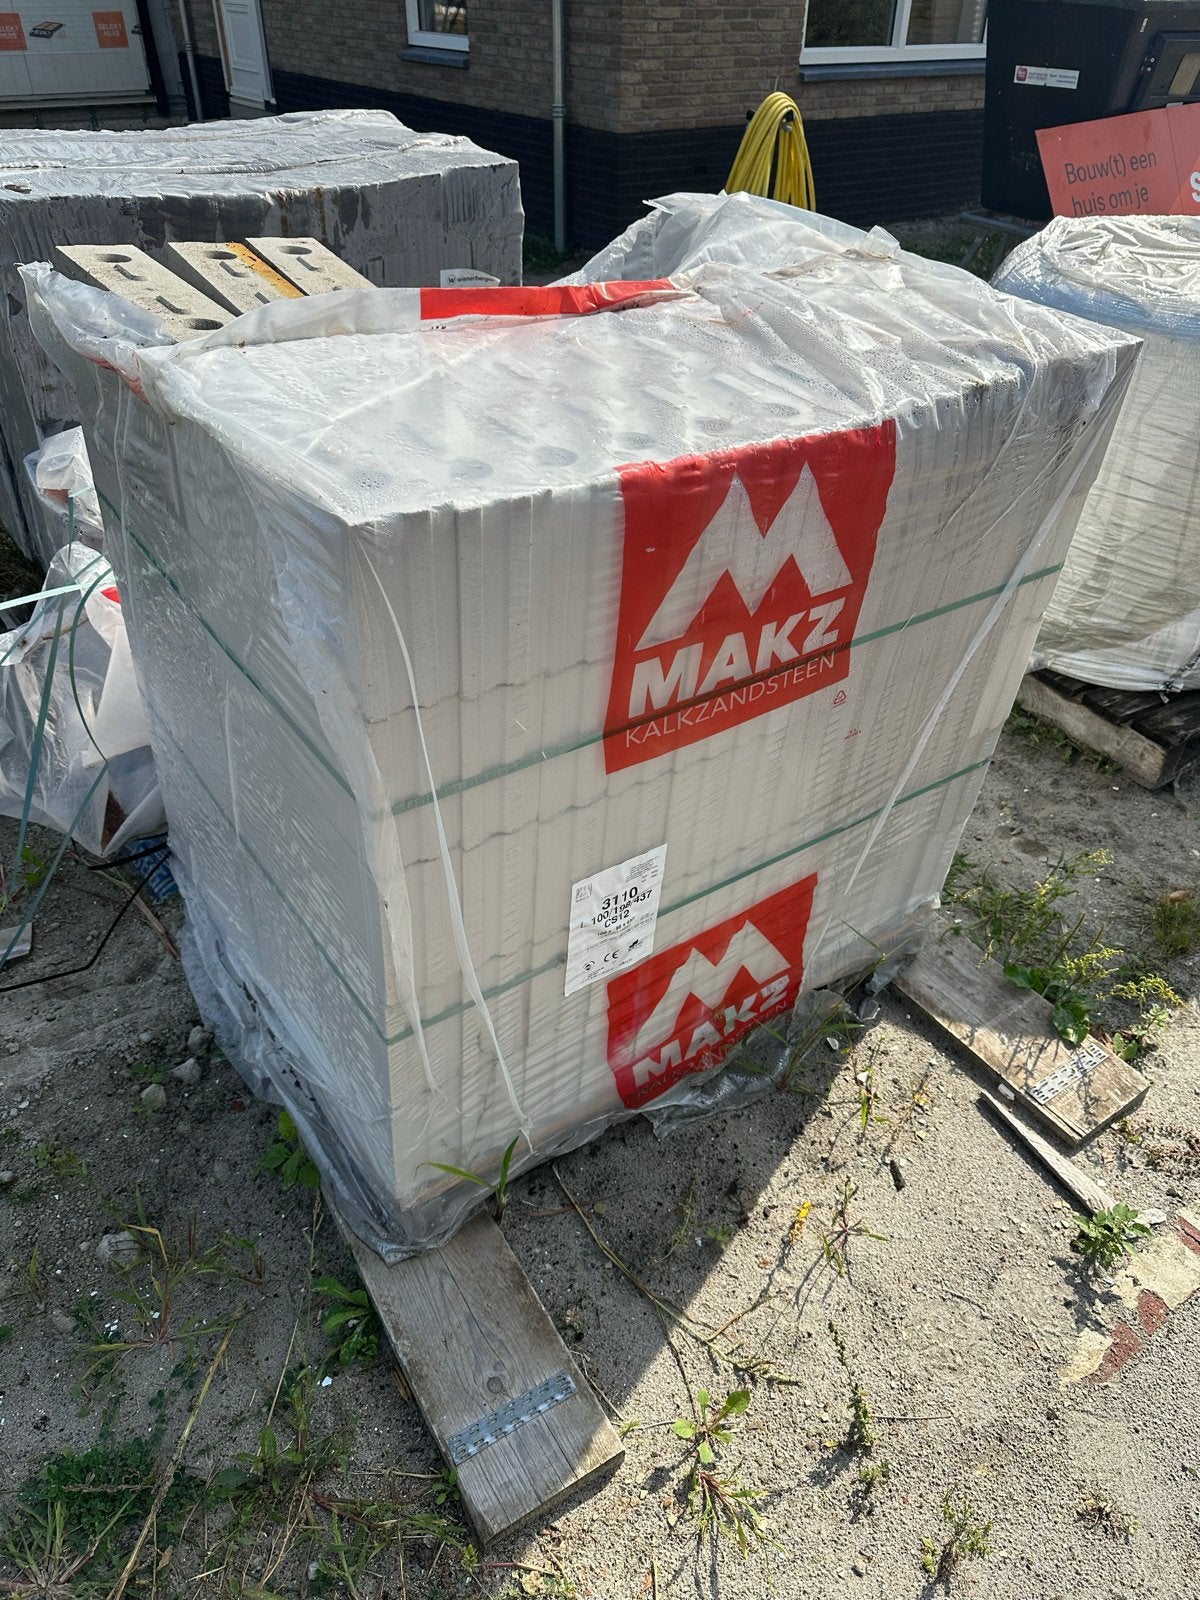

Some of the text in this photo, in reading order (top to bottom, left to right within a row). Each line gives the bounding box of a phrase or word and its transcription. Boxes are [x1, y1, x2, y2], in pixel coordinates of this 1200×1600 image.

[1064, 152, 1157, 185] Bouw(t) een
[1071, 183, 1150, 217] huis om je
[628, 597, 846, 719] MAKZ
[626, 654, 835, 748] KALKZANDSTEEN
[591, 889, 653, 925] 100/198/437
[602, 886, 639, 911] 3110
[604, 909, 630, 929] CS12
[632, 974, 790, 1088] MAKZ
